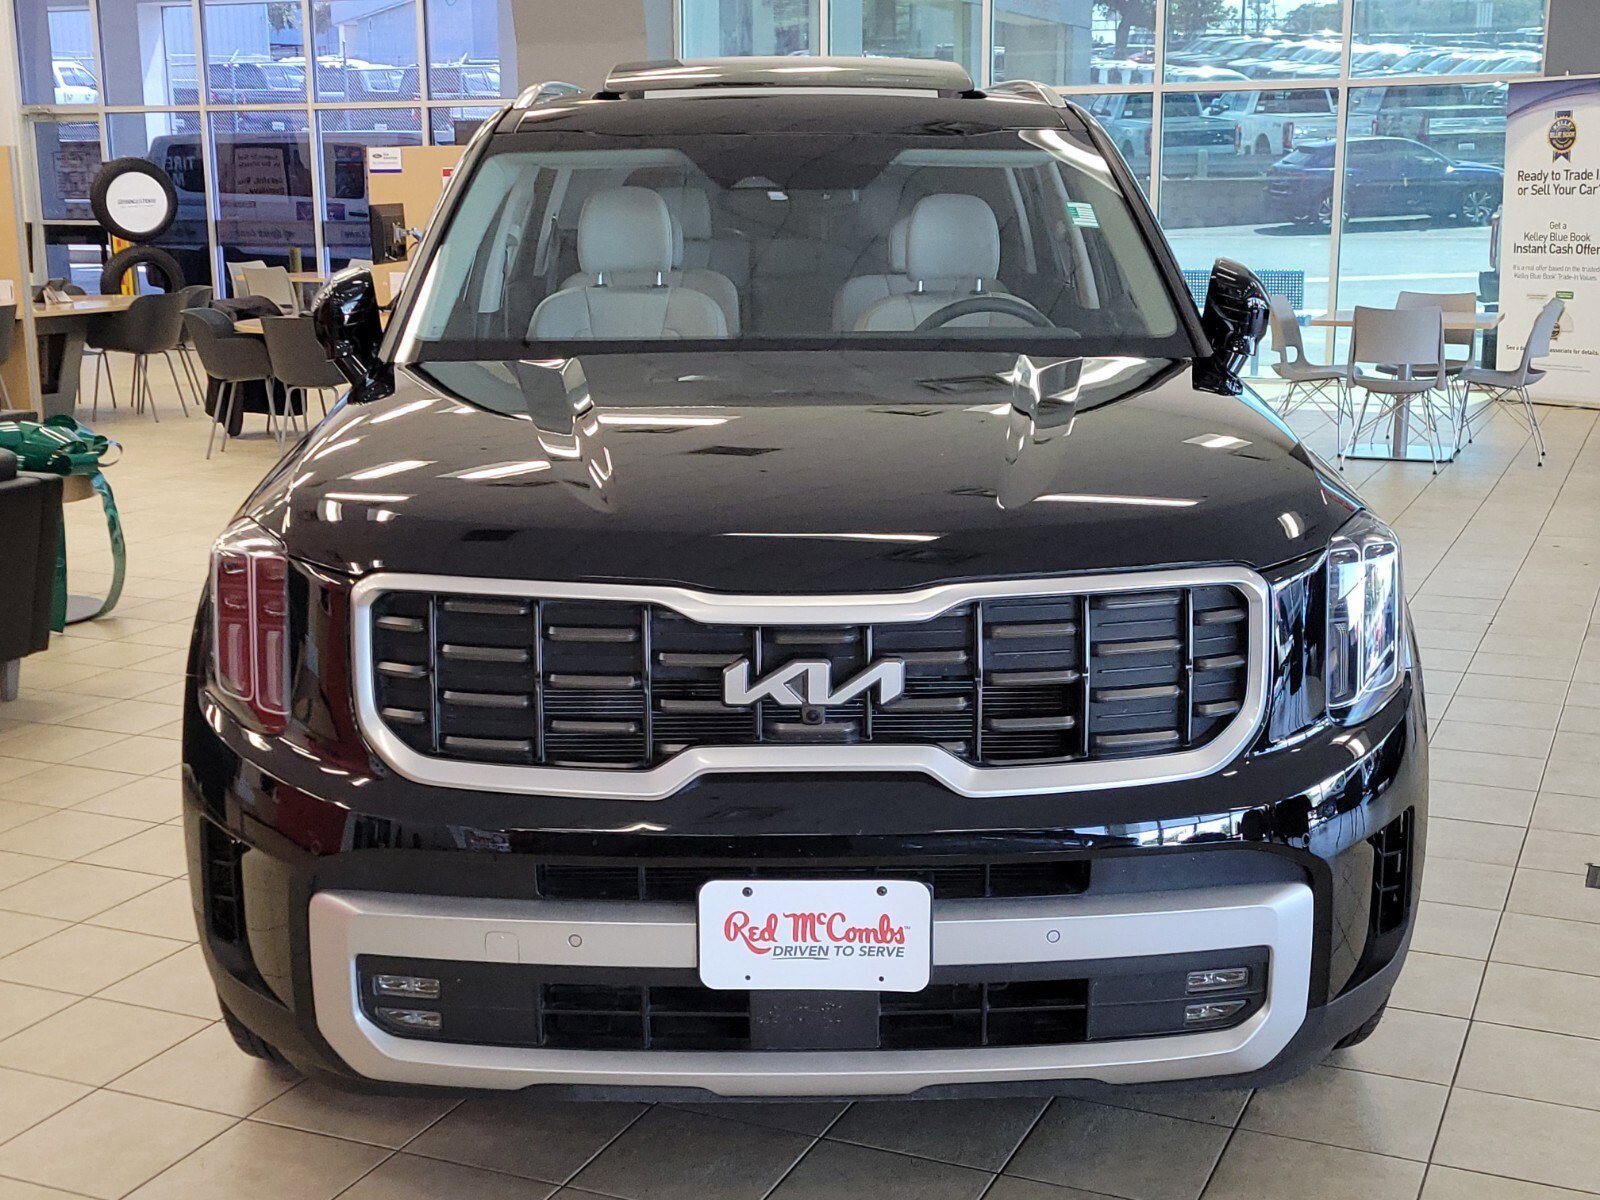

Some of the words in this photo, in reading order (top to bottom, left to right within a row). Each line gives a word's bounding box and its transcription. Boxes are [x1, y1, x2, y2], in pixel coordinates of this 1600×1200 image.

[1517, 169, 1549, 184] Ready
[1551, 170, 1561, 181] to
[1564, 169, 1593, 181] Trade
[1517, 187, 1528, 196] or
[1531, 184, 1550, 196] Sell
[1553, 184, 1577, 196] Your
[1549, 221, 1561, 230] Get
[1523, 232, 1548, 243] Kelley
[1549, 232, 1568, 242] Blue
[1570, 232, 1591, 242] Book
[1513, 243, 1547, 254] Instant
[1549, 243, 1573, 254] Cash
[1575, 243, 1600, 255] Offer
[724, 910, 778, 955] Red
[783, 911, 906, 945] McCombs
[772, 945, 830, 957] DRIVEN
[834, 945, 855, 957] TO
[858, 945, 906, 958] SERVE
